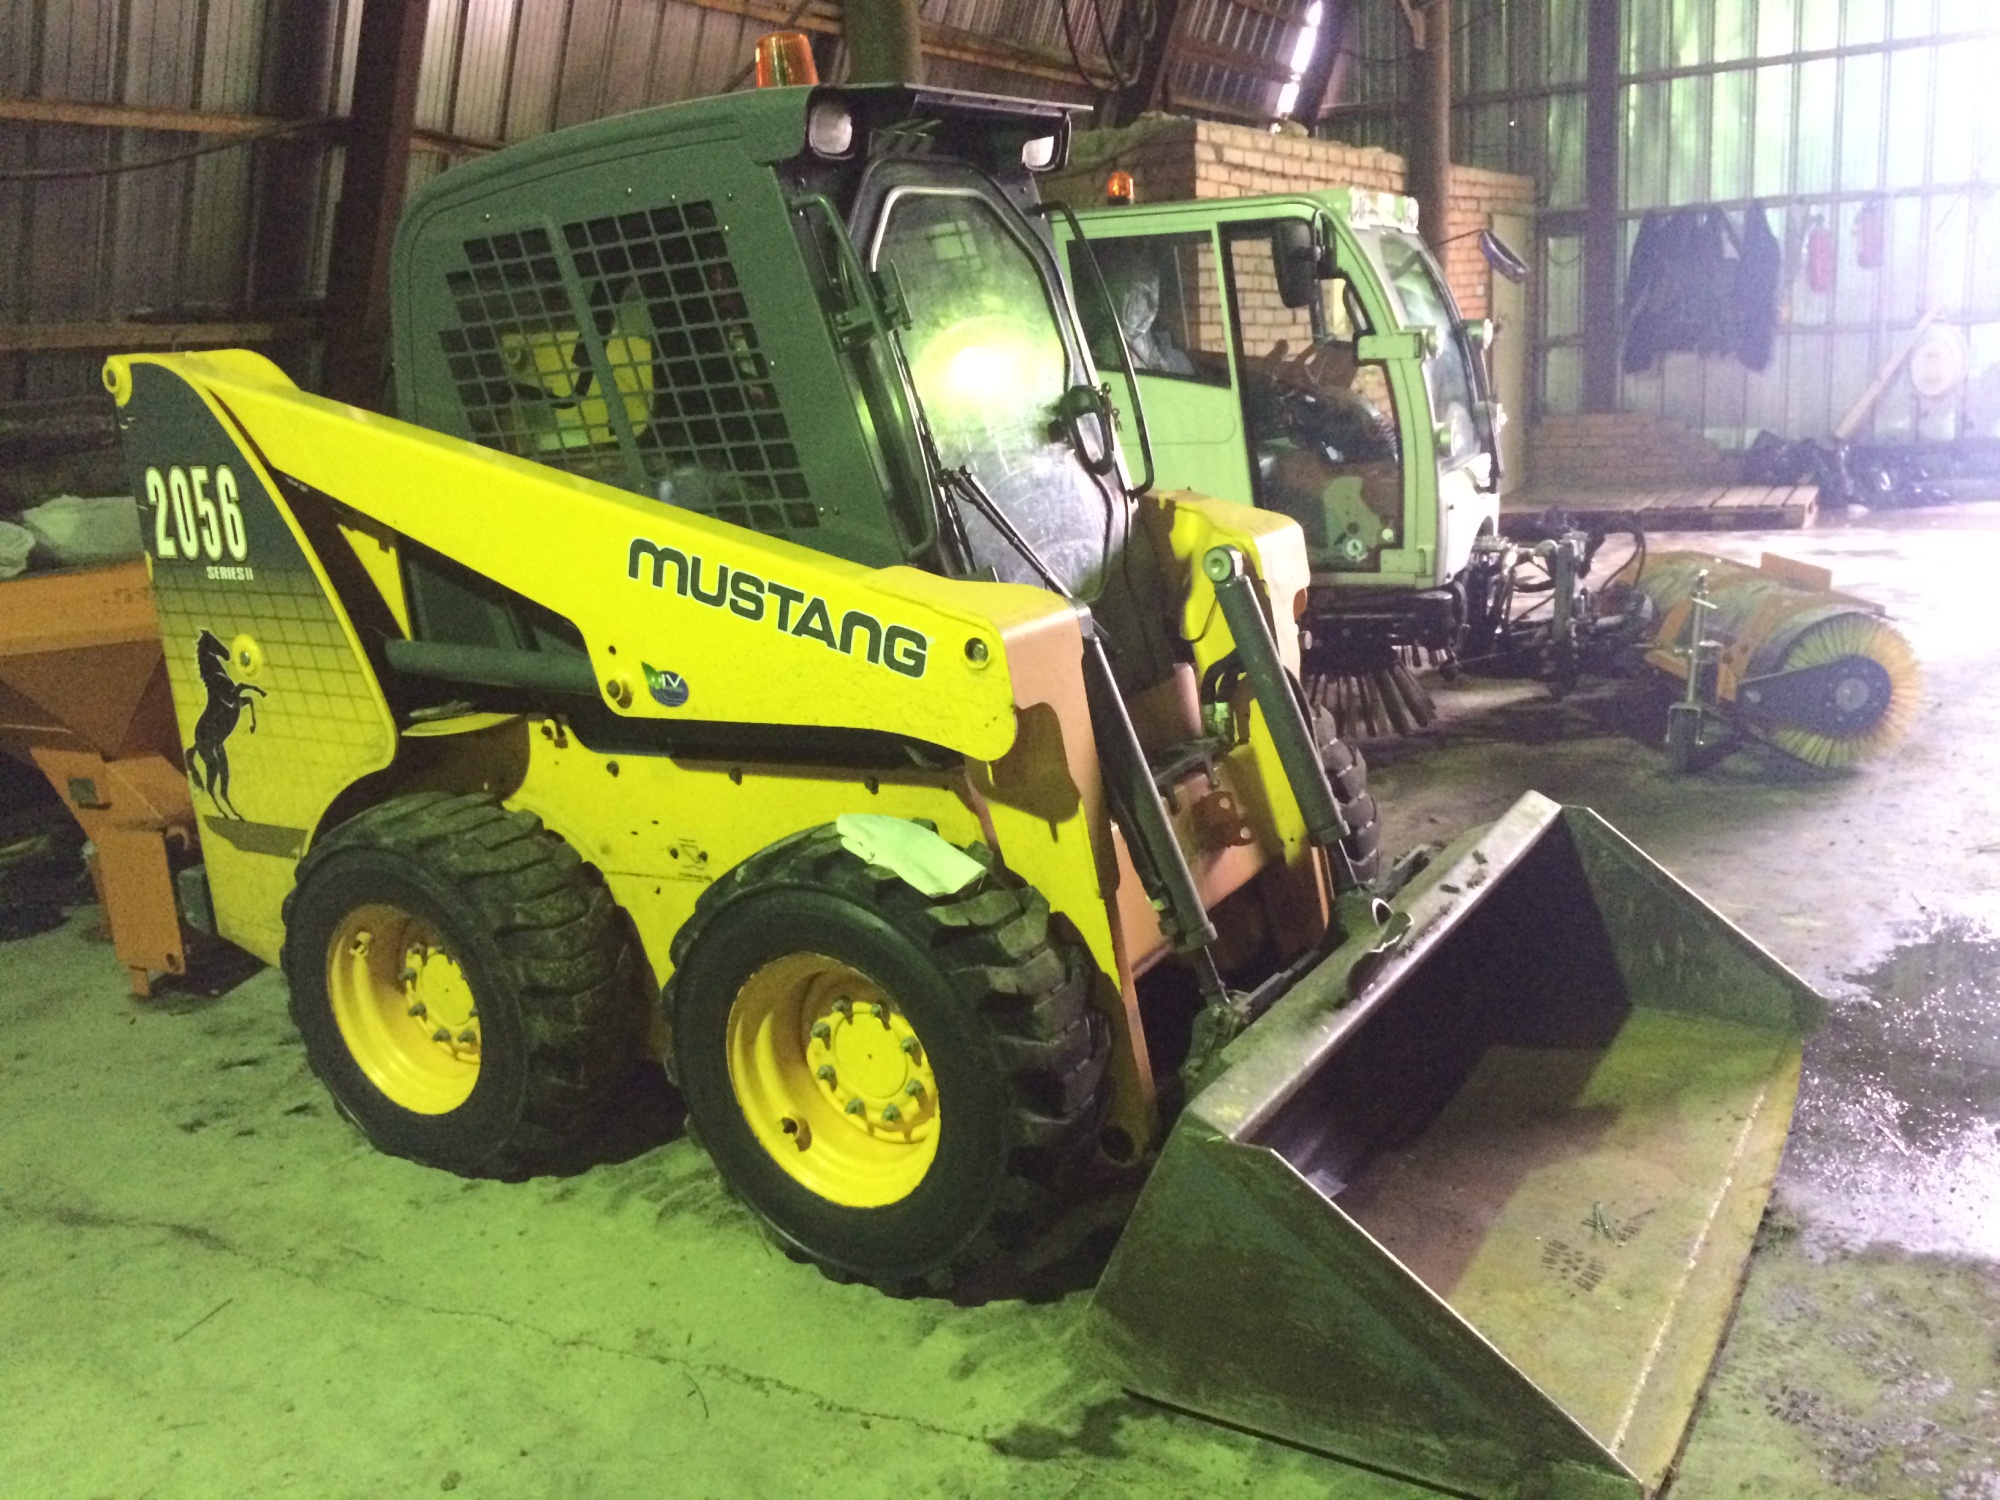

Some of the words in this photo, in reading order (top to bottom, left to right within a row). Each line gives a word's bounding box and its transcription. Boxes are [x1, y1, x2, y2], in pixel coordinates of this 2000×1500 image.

[145, 464, 248, 562] 2056
[206, 565, 245, 580] SERIES
[627, 538, 928, 679] MUSTANG
